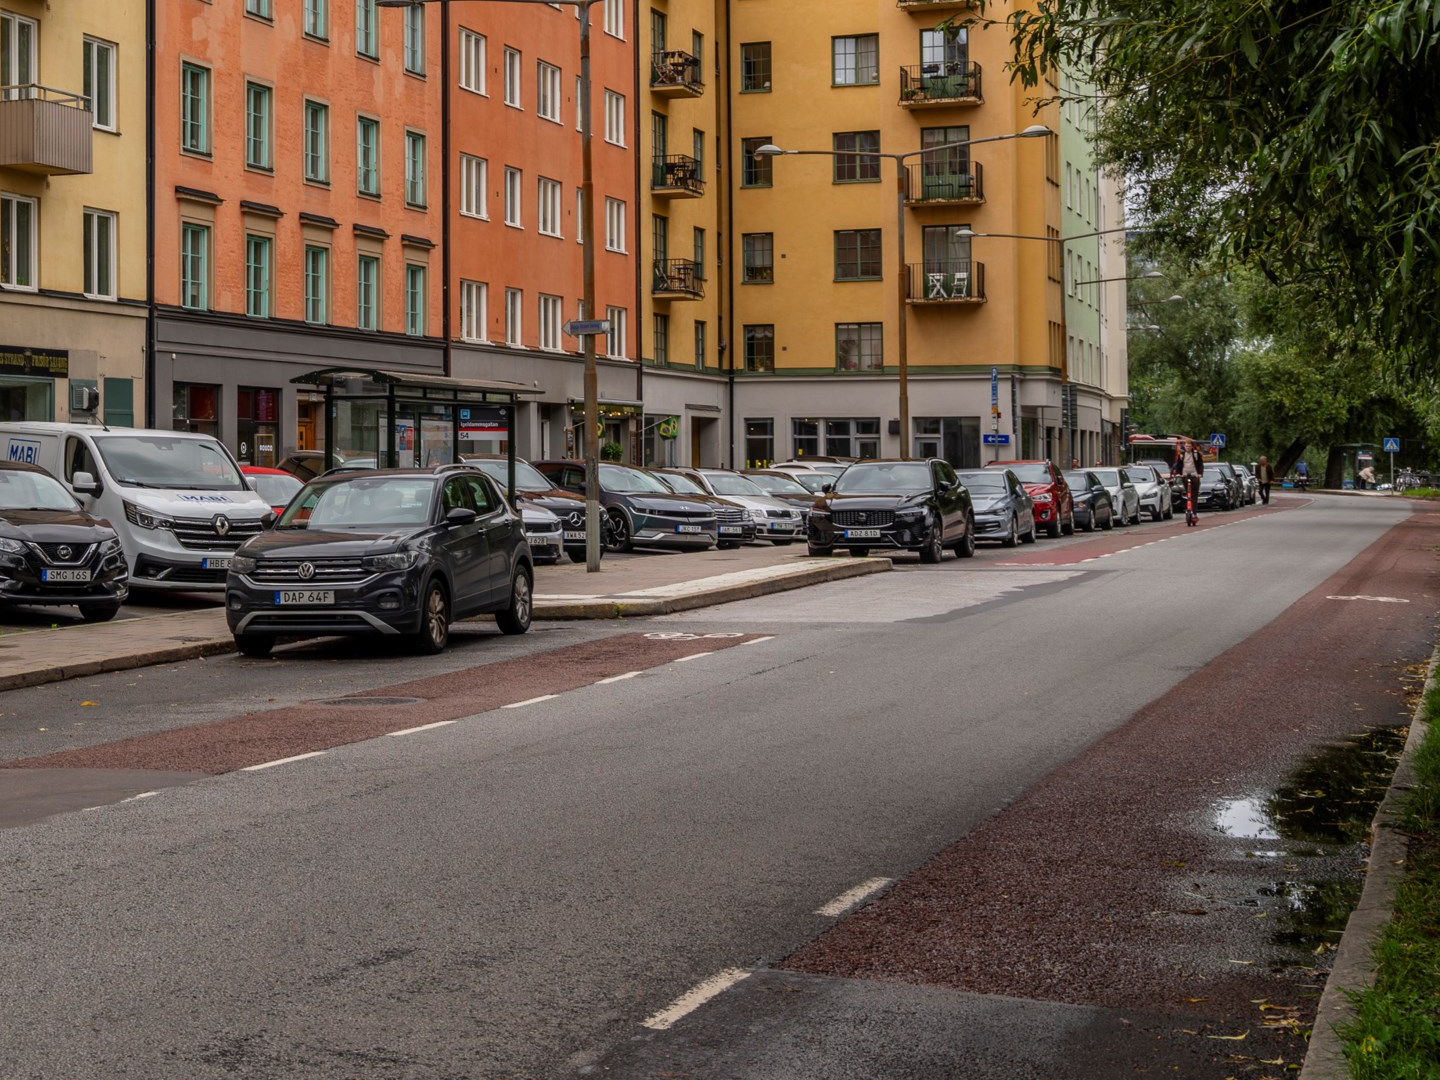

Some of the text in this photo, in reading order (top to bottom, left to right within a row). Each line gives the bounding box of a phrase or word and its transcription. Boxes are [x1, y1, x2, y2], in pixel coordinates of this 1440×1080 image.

[9, 444, 38, 465] MABI
[209, 559, 225, 568] HBE
[50, 570, 87, 580] SMG 16S
[283, 591, 329, 603] DAP 64F
